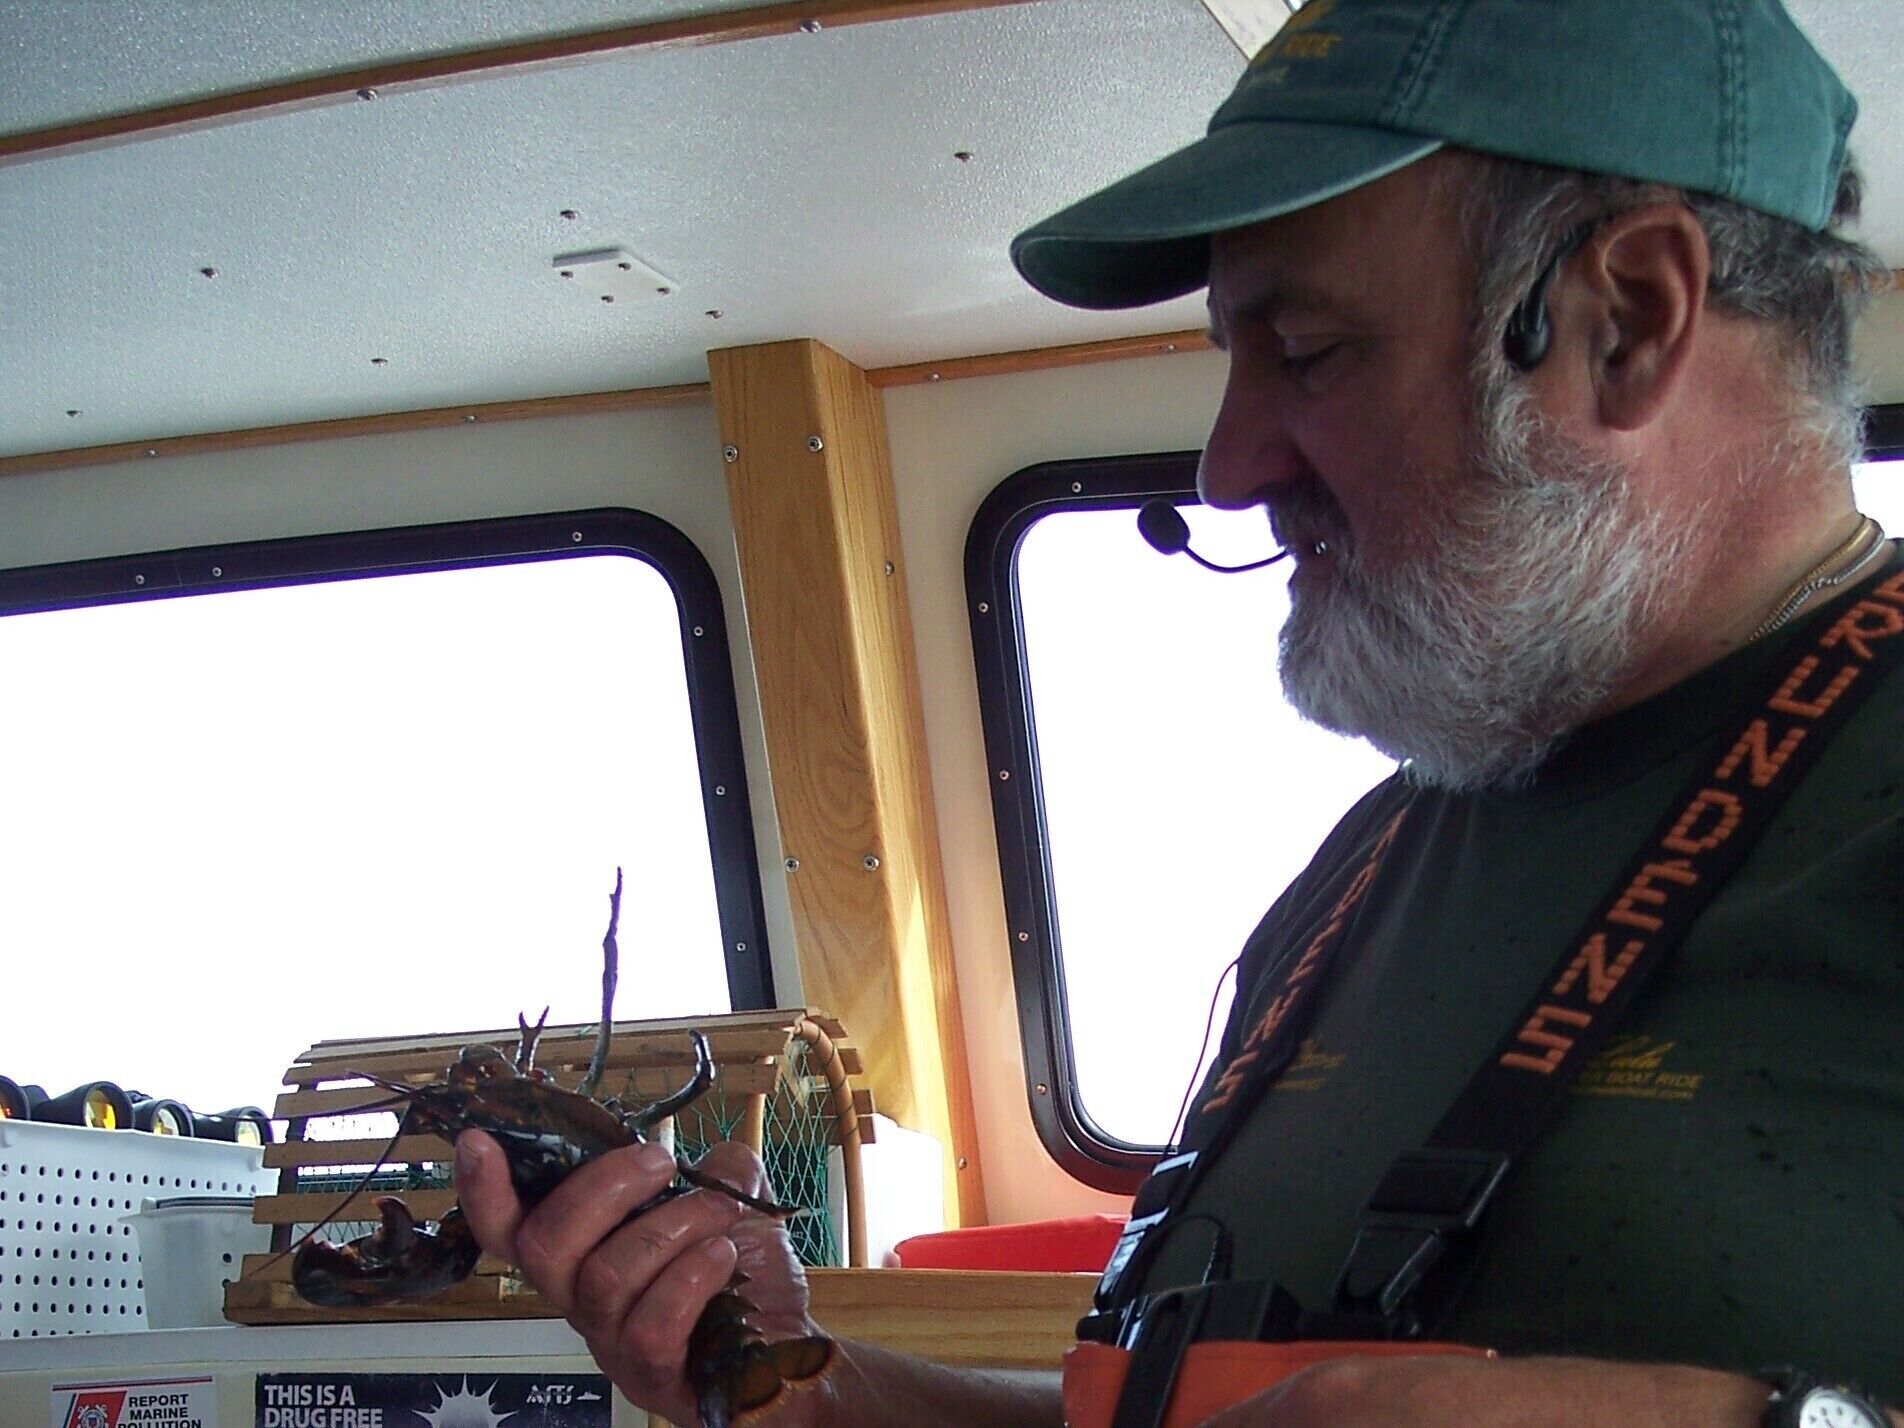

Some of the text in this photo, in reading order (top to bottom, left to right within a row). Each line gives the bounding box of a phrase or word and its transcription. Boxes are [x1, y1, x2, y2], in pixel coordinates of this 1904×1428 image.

[128, 1393, 189, 1408] REPORT
[264, 1384, 356, 1406] THIS IS A
[129, 1407, 189, 1421] MARINE
[264, 1407, 383, 1428] DRUG FREE
